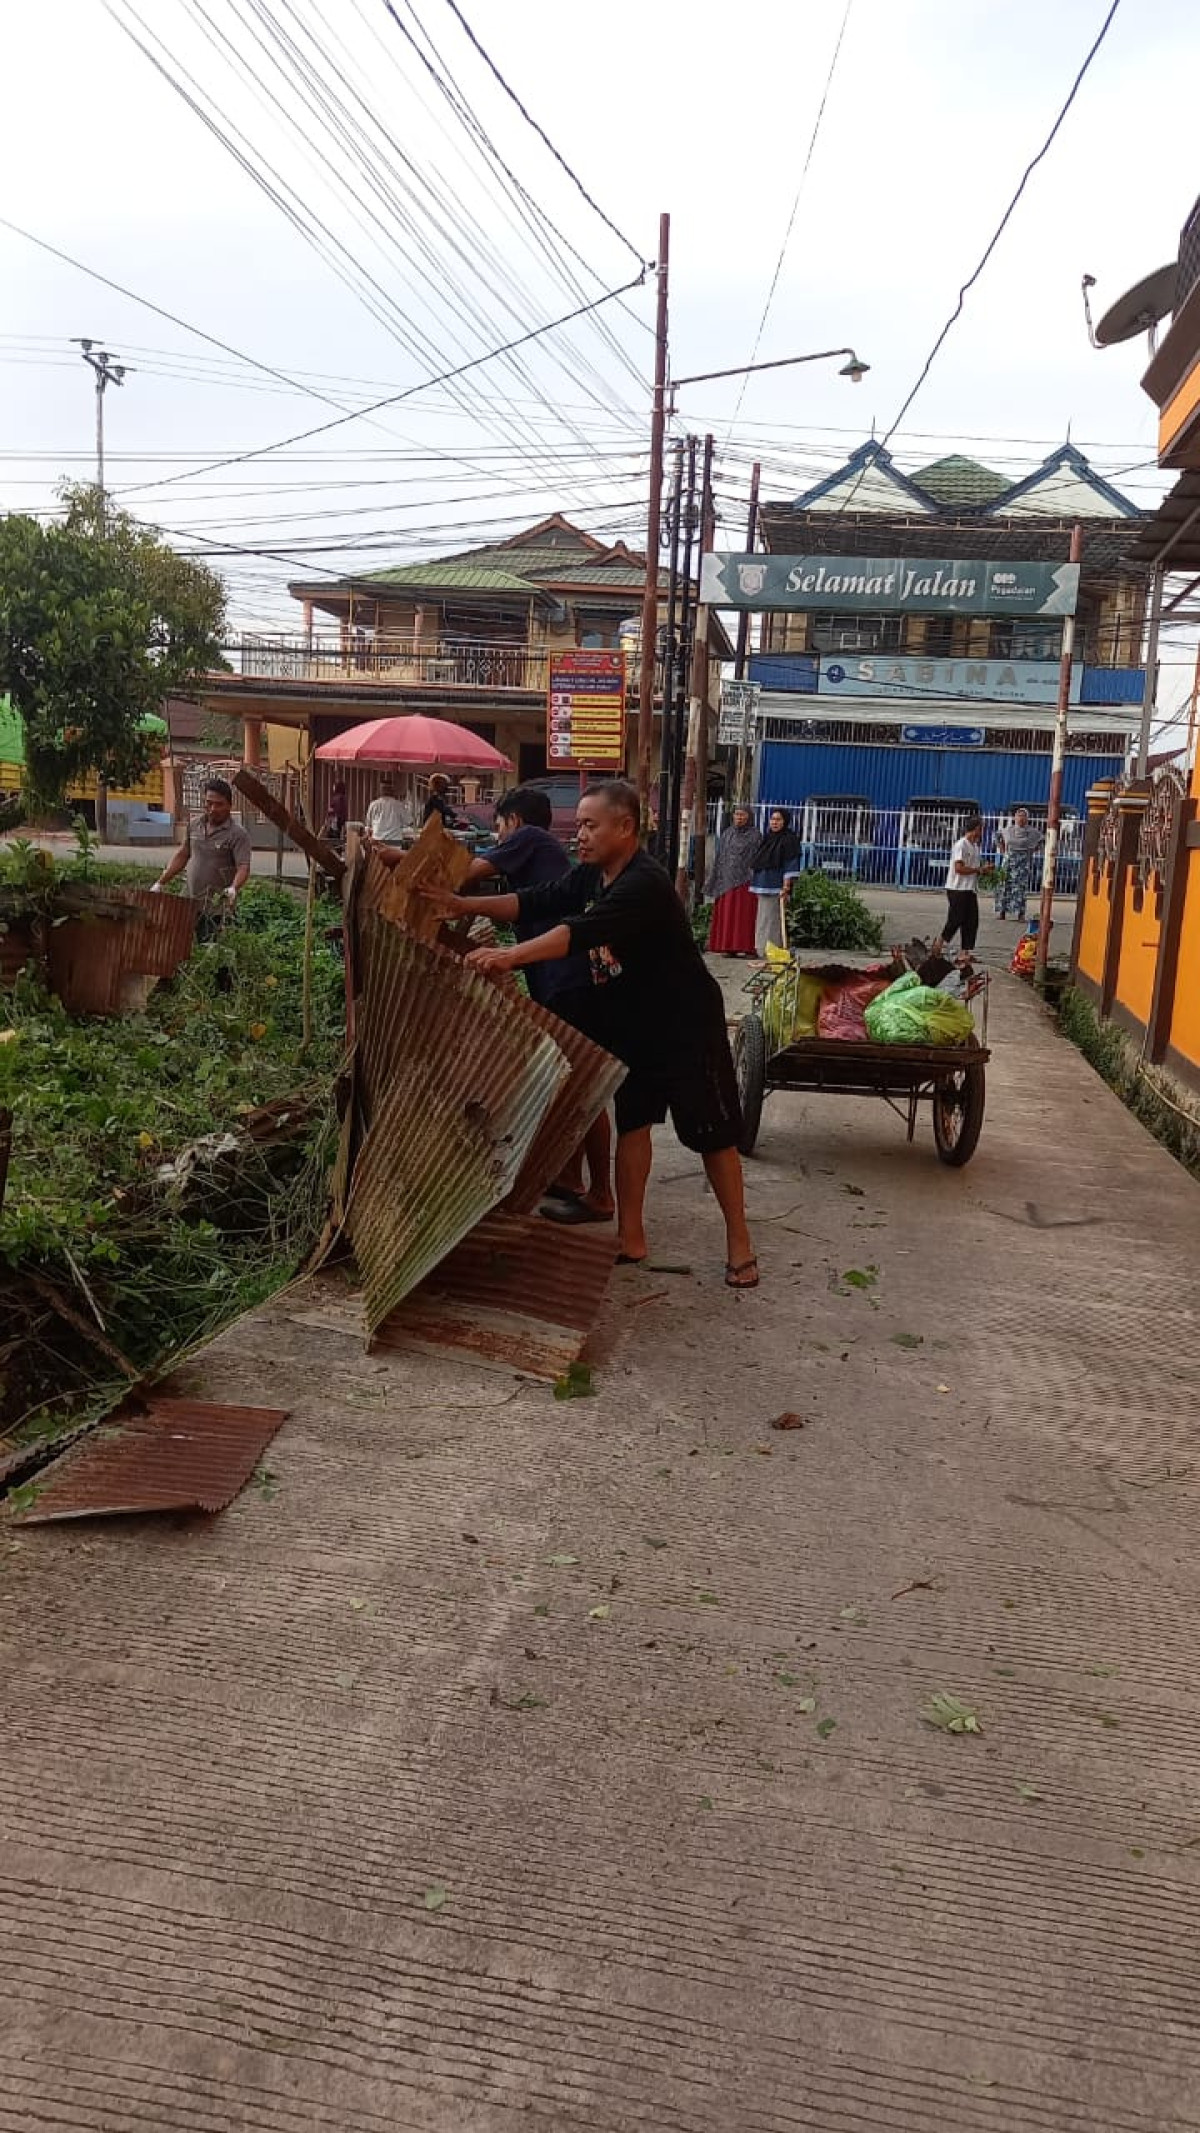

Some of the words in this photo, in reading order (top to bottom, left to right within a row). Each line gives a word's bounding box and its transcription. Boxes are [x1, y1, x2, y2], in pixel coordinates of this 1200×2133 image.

[785, 567, 895, 595] Selamat
[900, 570, 976, 600] Jalan
[858, 661, 1018, 686] SABINA
